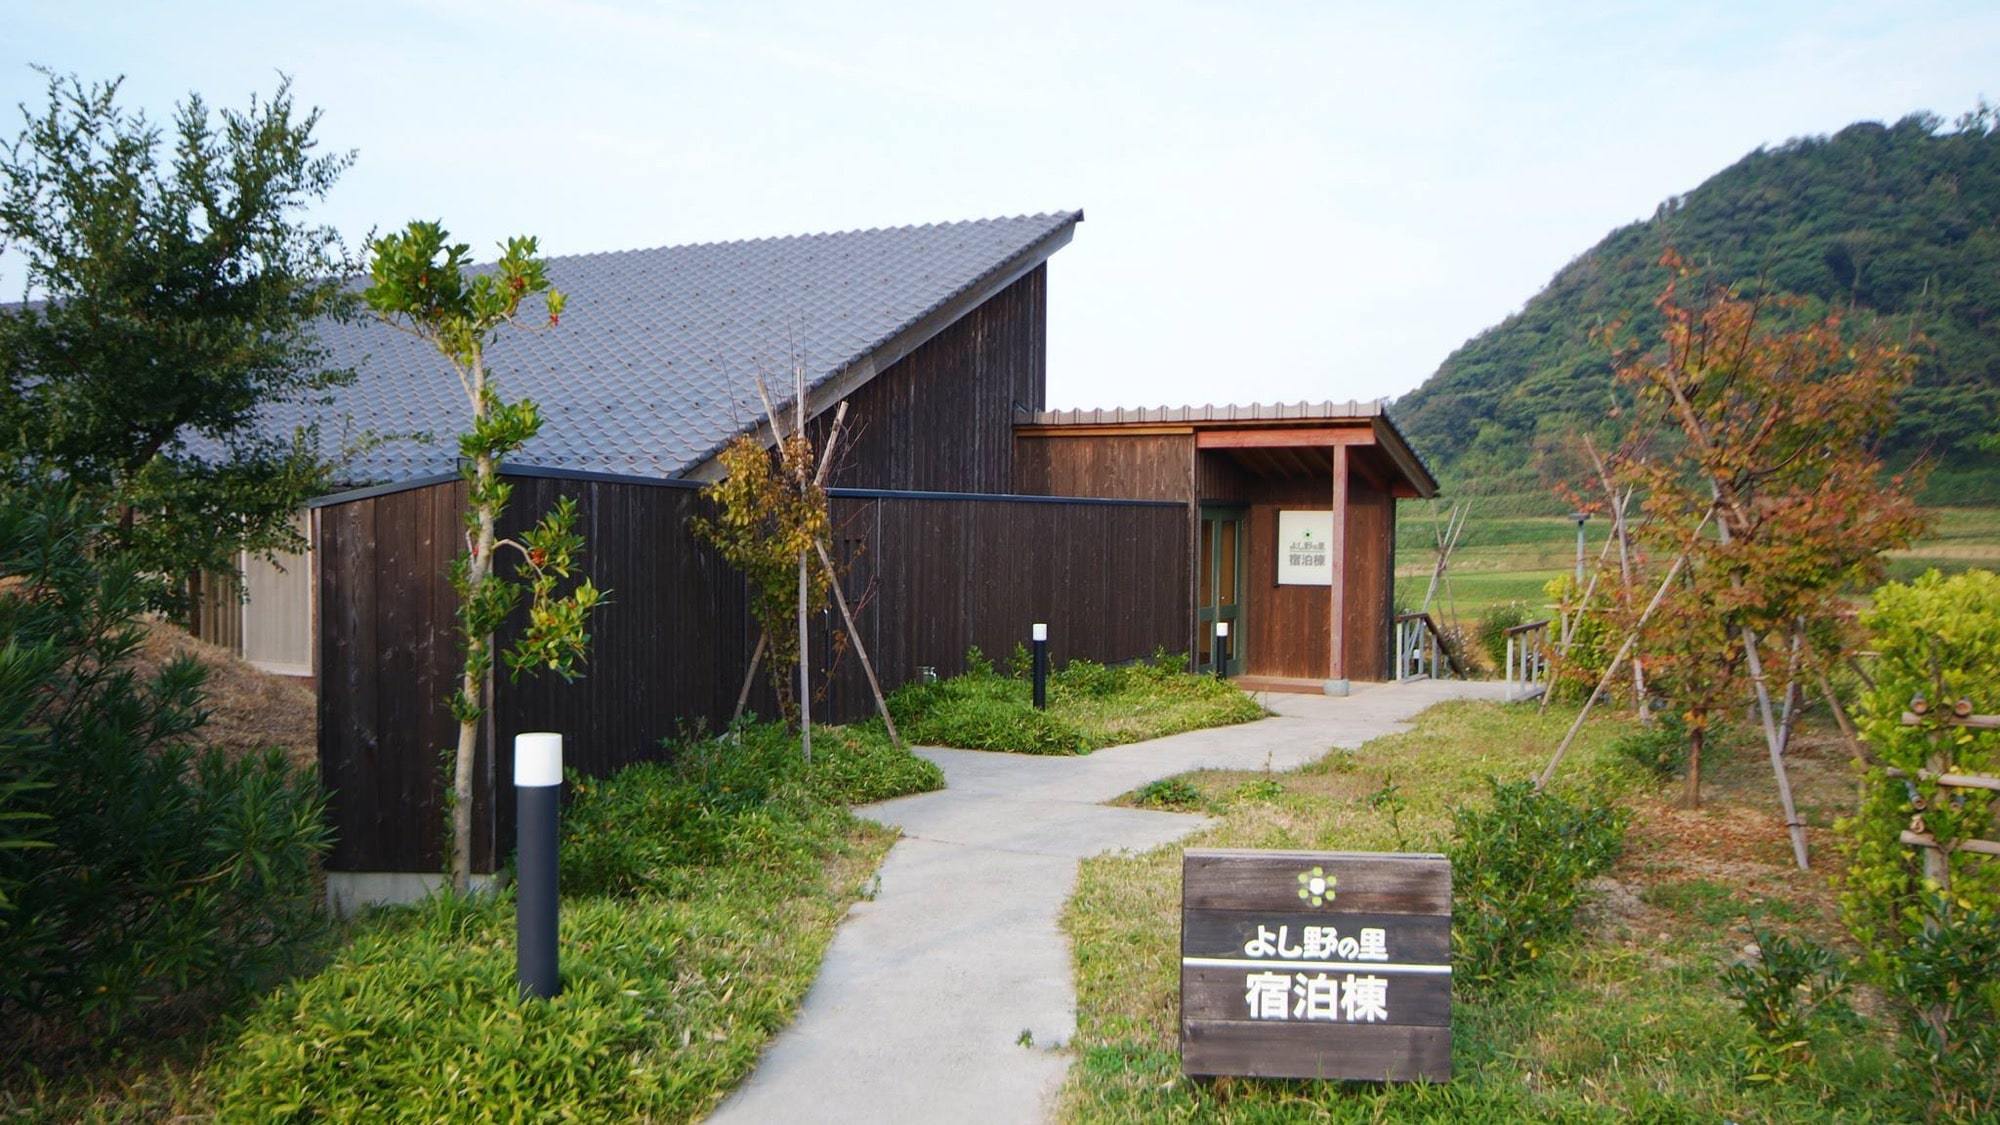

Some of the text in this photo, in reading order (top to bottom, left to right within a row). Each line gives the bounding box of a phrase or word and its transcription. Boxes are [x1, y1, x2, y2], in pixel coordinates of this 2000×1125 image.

[1289, 554, 1326, 566] 宿泊棟
[1244, 924, 1389, 961] よし野の里
[1245, 971, 1388, 1022] 宿泊棟
